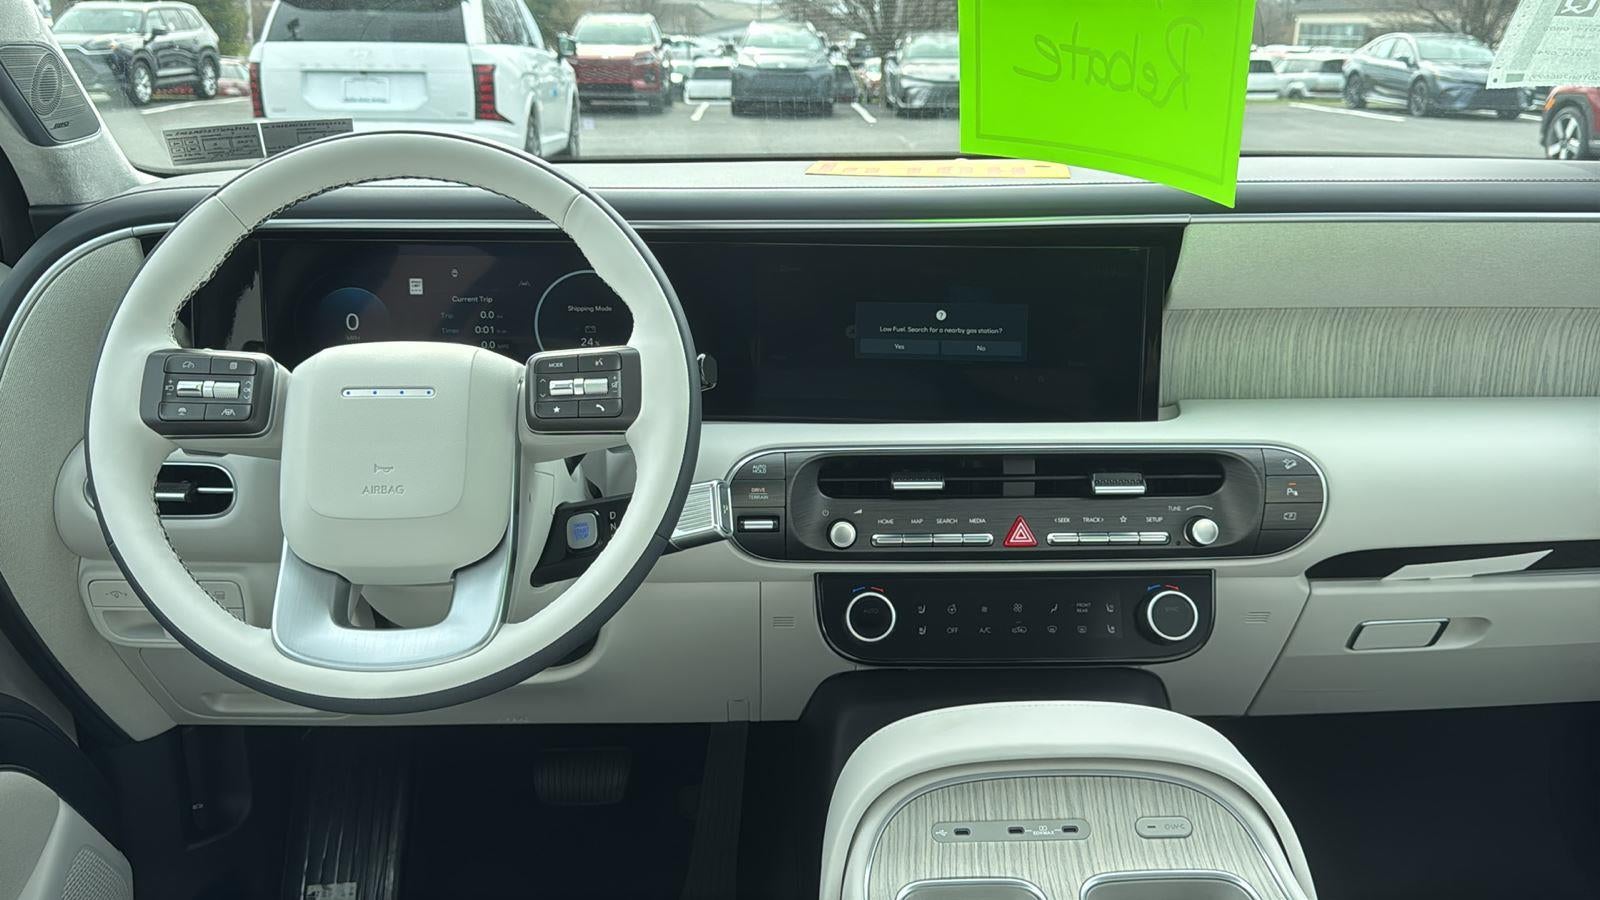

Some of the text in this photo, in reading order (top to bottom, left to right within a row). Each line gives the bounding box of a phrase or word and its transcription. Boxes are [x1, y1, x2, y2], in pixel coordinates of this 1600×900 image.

[451, 295, 493, 303] Current Trip
[567, 304, 613, 313] Shipping Mode
[480, 310, 495, 319] 0.0
[346, 312, 360, 331] 0
[474, 325, 495, 334] 0:01
[944, 327, 965, 335] nearby
[361, 484, 406, 496] AIRBAG
[609, 511, 617, 520] D
[946, 626, 959, 634] OFF
[978, 626, 992, 634] A/C
